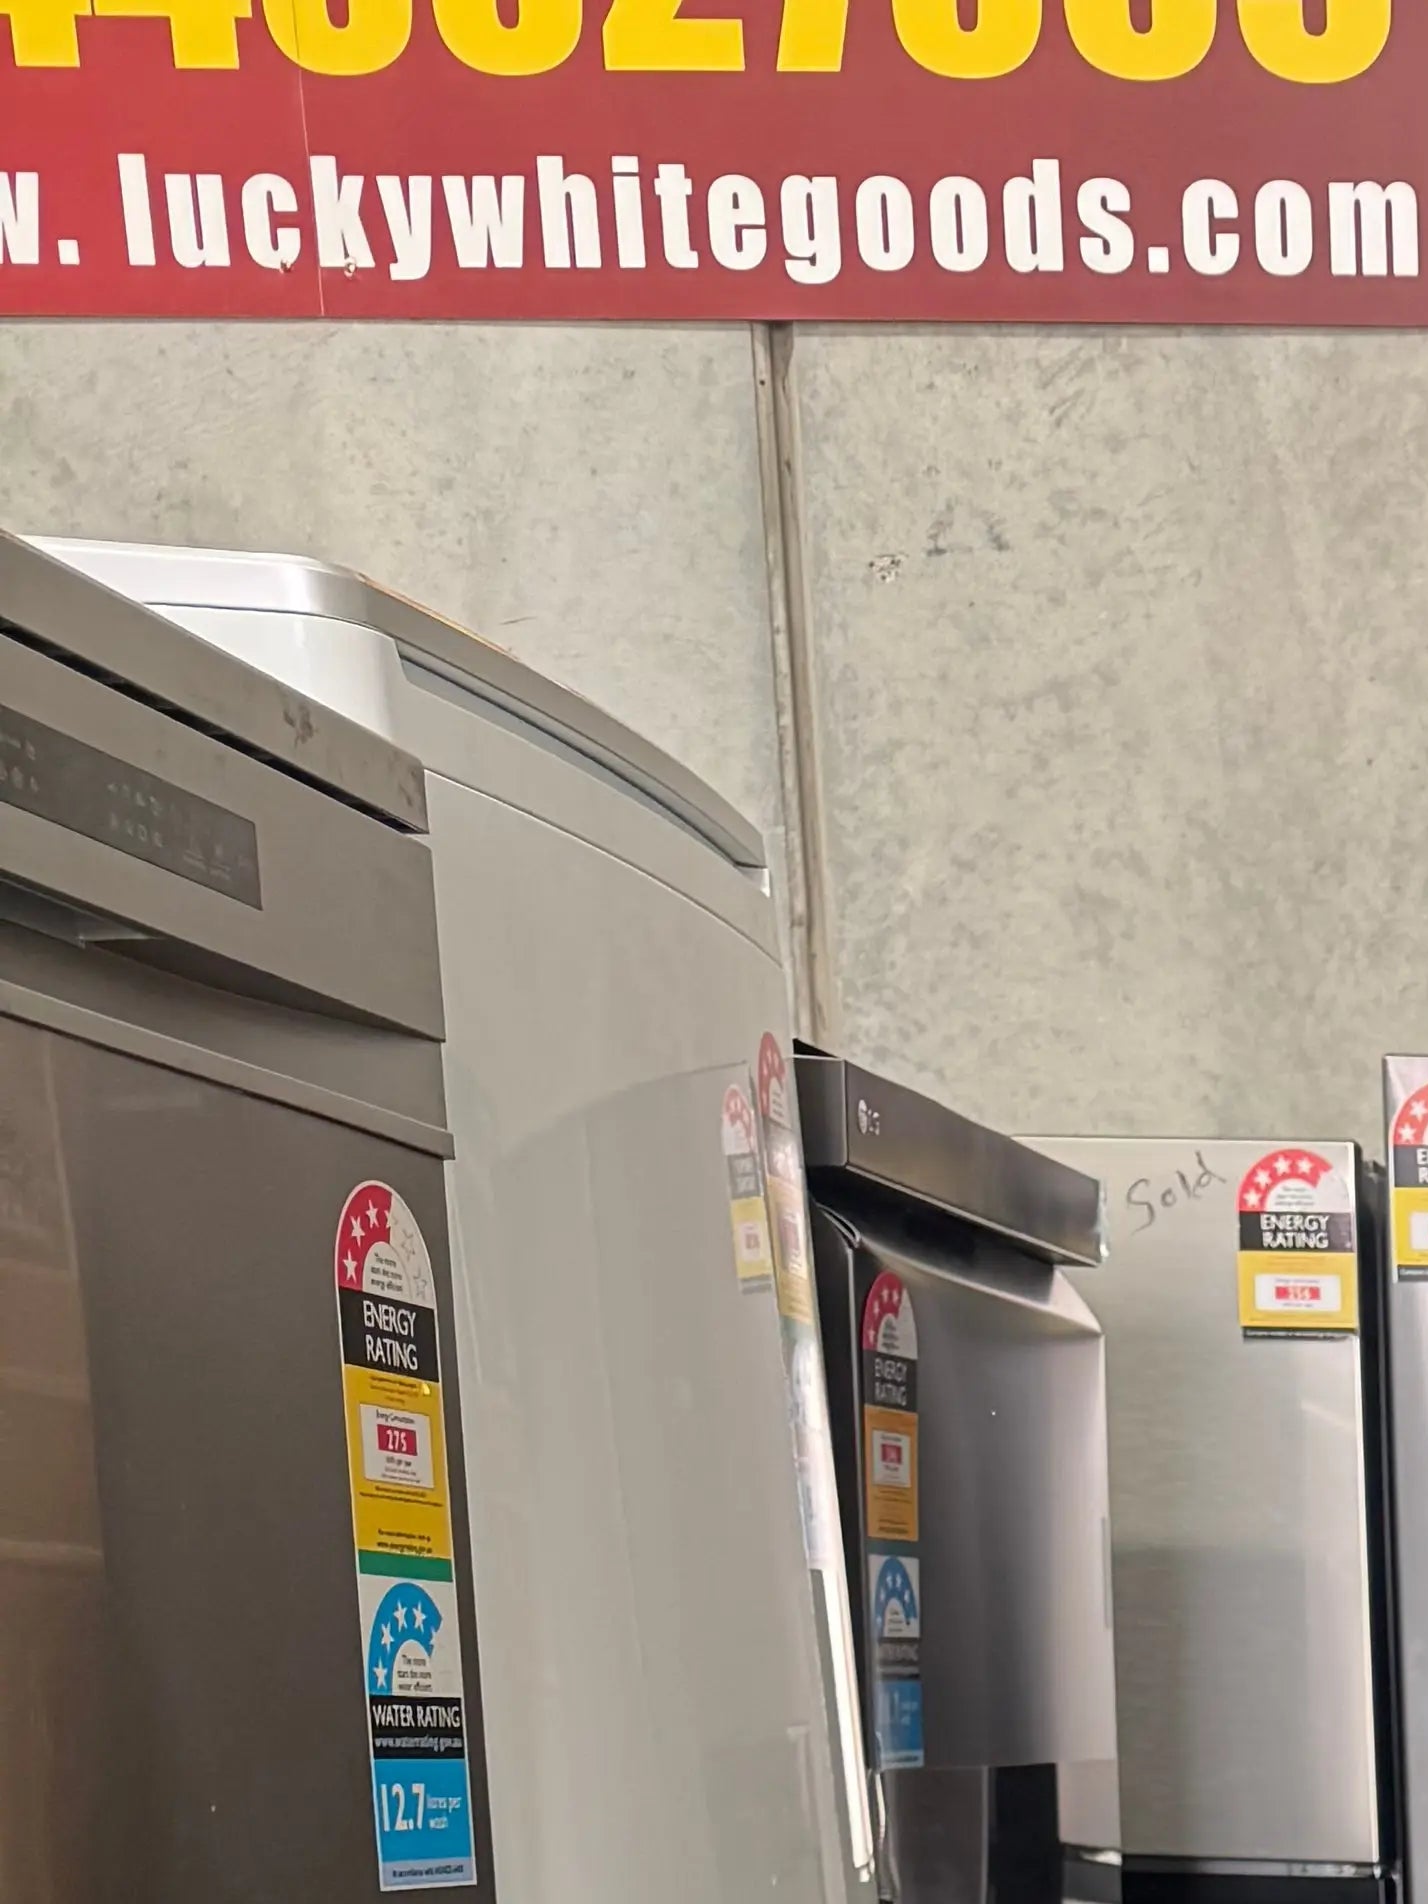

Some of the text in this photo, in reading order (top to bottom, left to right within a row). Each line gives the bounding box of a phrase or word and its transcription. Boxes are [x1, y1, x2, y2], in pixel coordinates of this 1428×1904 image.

[117, 153, 1419, 285] luckywhitegoods.com
[1126, 1150, 1227, 1236] Sold
[1259, 1213, 1330, 1231] ENERGY
[1262, 1232, 1329, 1249] RATING
[363, 1300, 416, 1338] ENERGY
[365, 1334, 418, 1371] RATING
[372, 1704, 460, 1728] WATER RATING
[381, 1783, 425, 1832] 12.7
